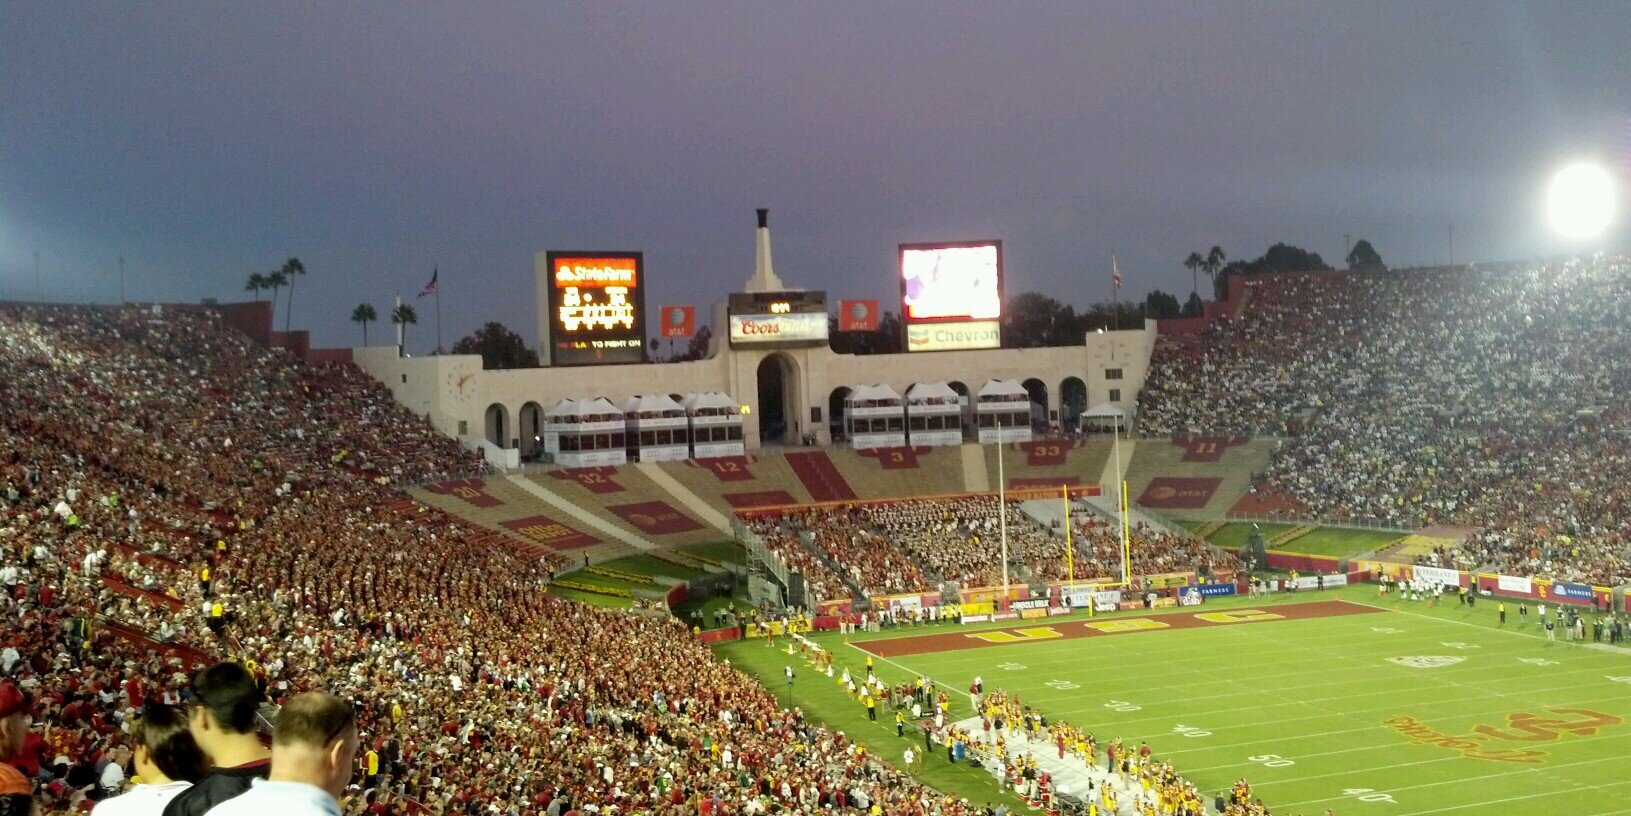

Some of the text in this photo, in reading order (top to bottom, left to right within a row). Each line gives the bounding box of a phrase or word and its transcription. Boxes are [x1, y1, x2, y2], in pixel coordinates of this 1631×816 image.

[741, 321, 781, 335] Coors
[935, 329, 999, 343] Chevron
[891, 452, 904, 463] 3
[1035, 446, 1060, 457] 33
[715, 461, 740, 473] 12
[578, 472, 607, 484] 32
[1095, 603, 1116, 612] Jeep
[964, 610, 1286, 643] USC
[1248, 754, 1295, 768] 50
